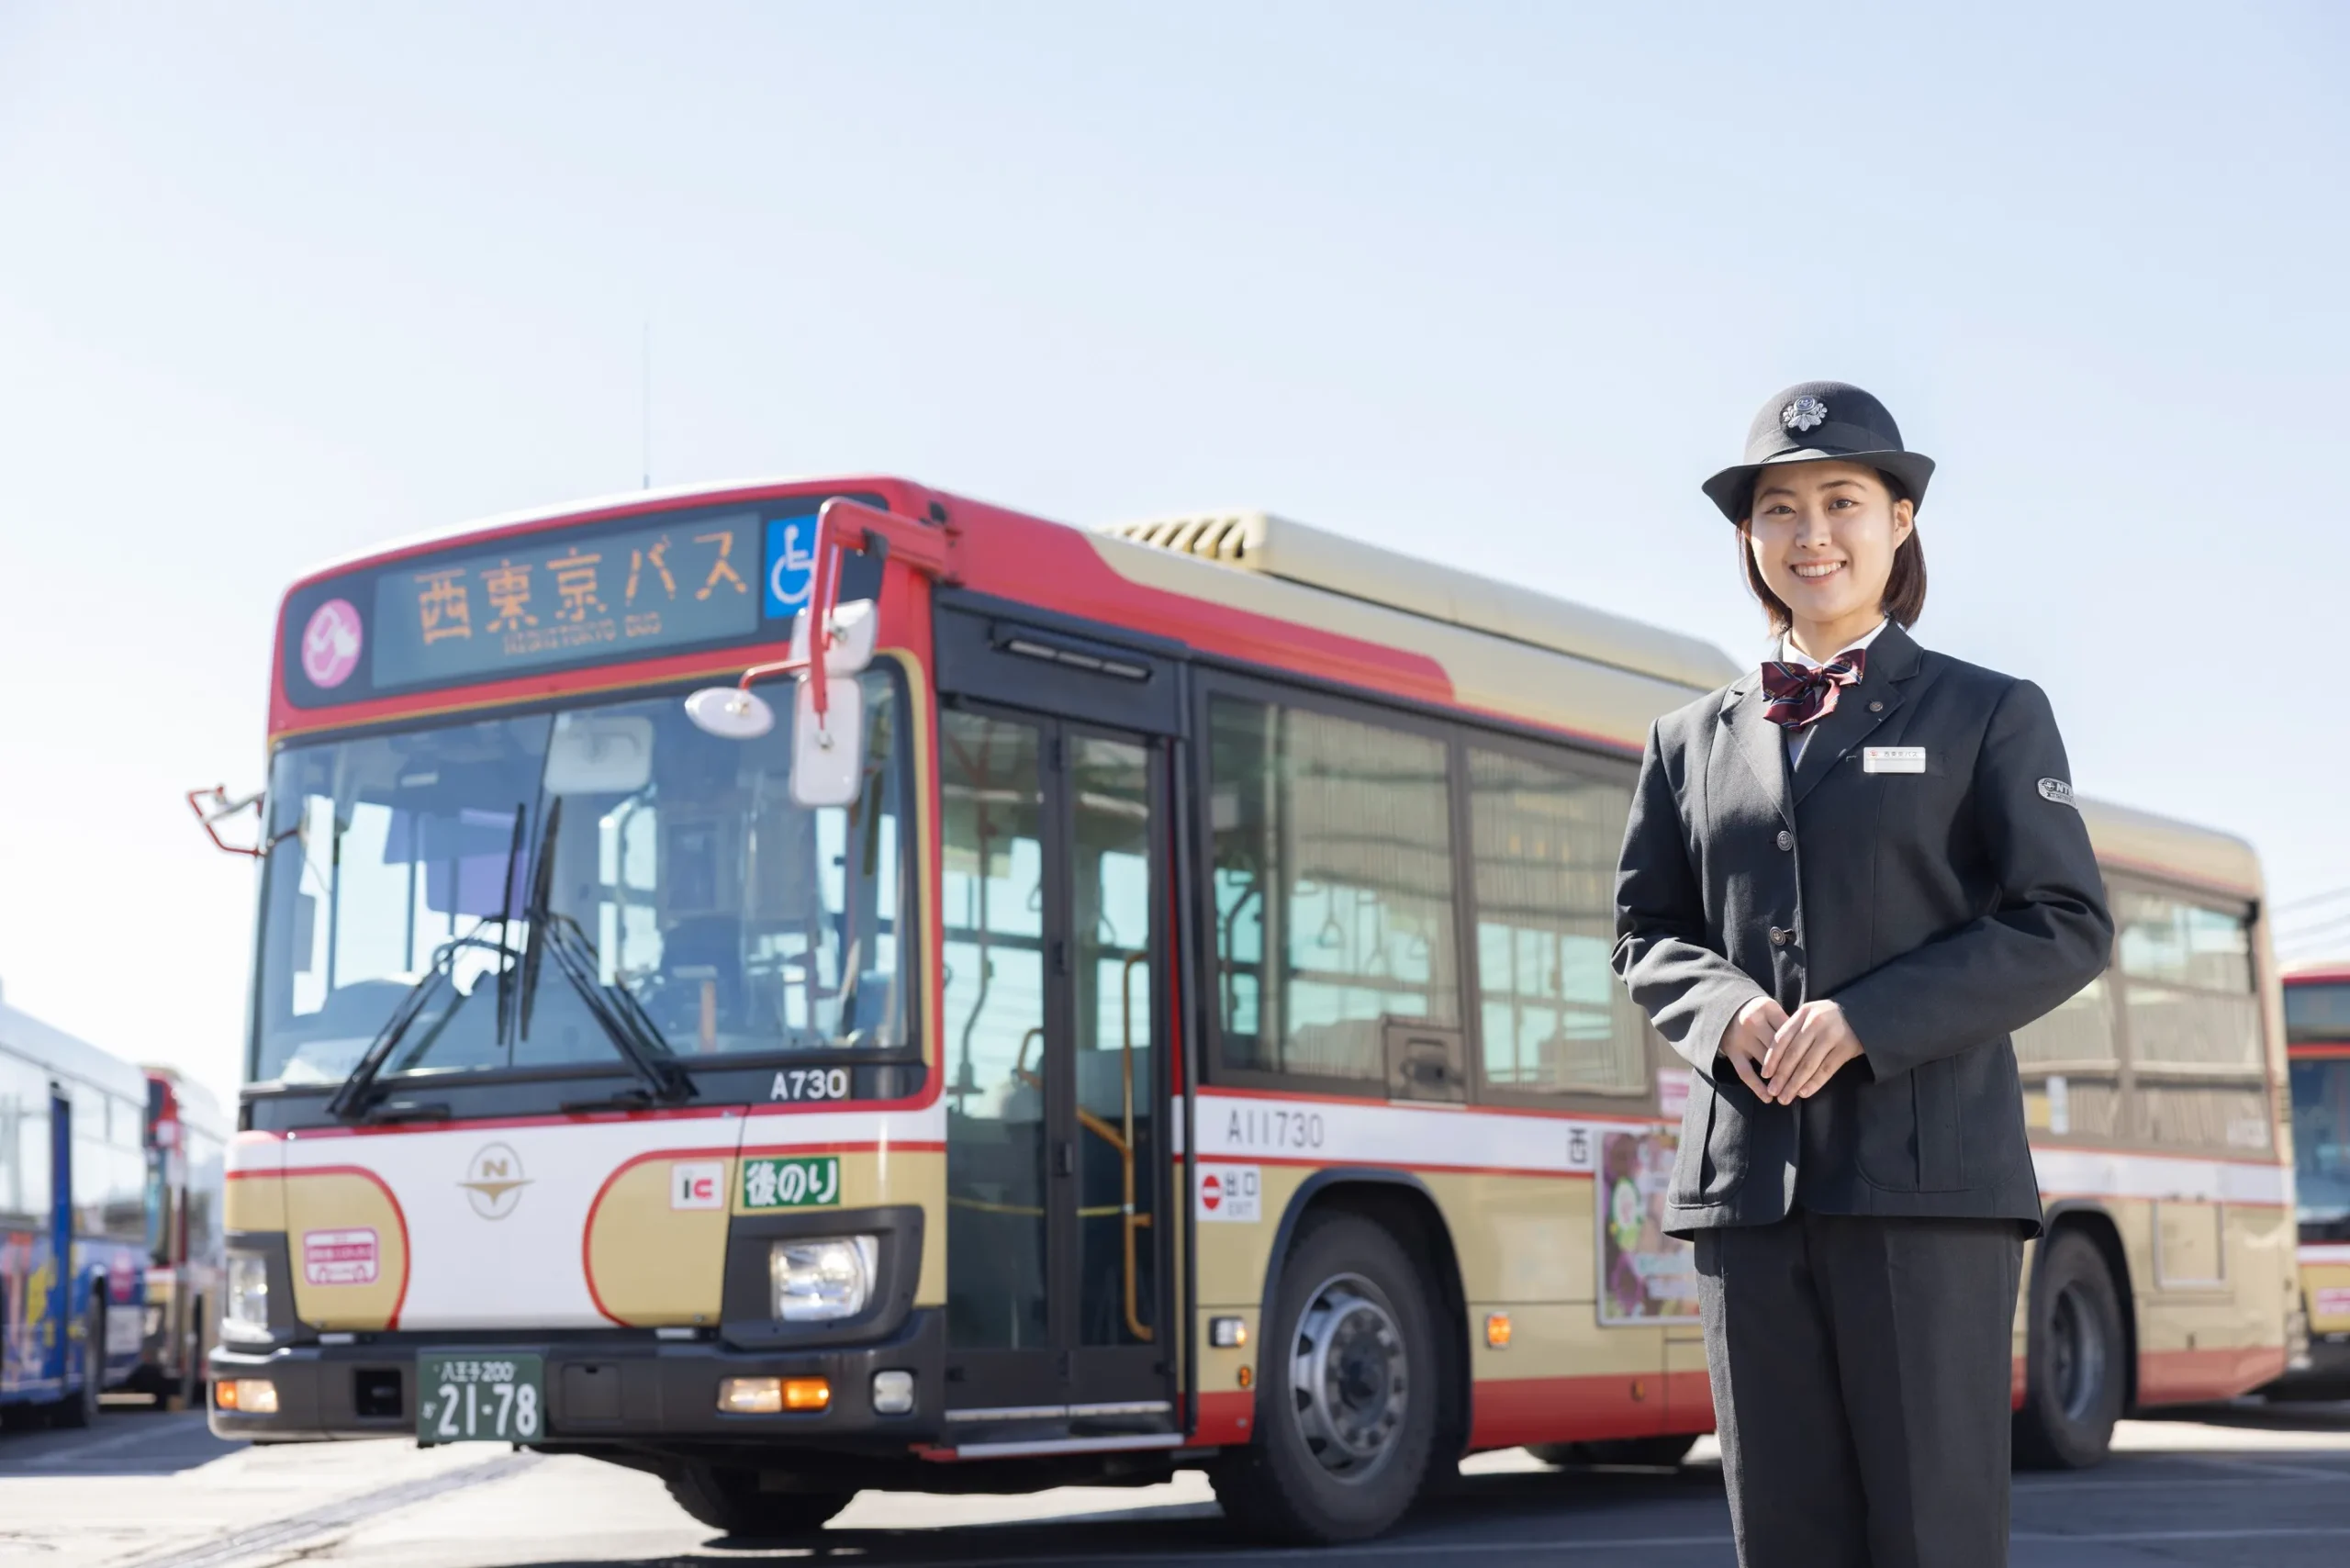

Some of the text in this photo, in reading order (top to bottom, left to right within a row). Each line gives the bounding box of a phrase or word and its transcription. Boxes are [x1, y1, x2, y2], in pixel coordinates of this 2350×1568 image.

[415, 532, 747, 644] 西東京バス
[770, 1069, 848, 1101] A730
[1226, 1108, 1325, 1149] A11730
[745, 1159, 838, 1206] 後のり
